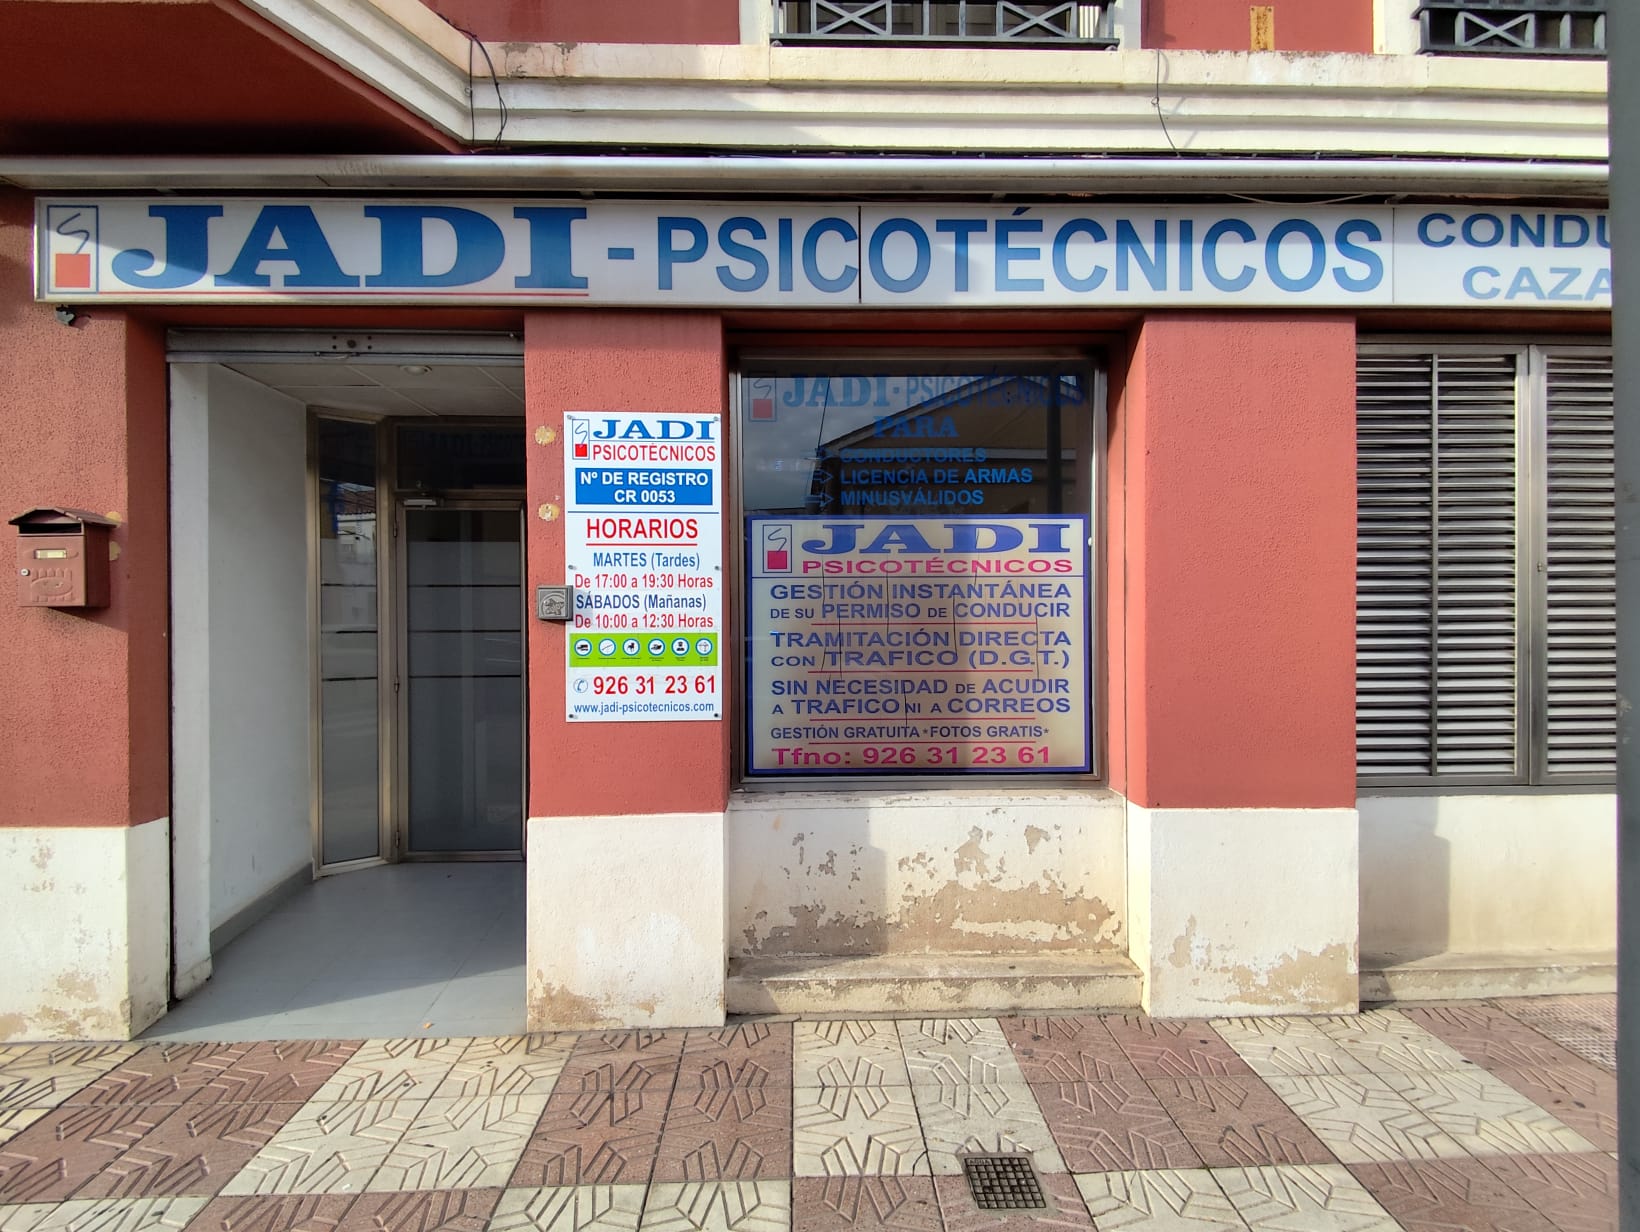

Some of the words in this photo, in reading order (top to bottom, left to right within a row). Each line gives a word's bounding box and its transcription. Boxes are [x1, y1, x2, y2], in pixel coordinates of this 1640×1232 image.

[111, 205, 589, 289] JADI
[658, 206, 1385, 294] PSICOTÉCNICOS
[782, 374, 890, 408] JADI
[593, 419, 715, 440] JADI
[873, 415, 960, 439] PARA
[593, 443, 716, 462] PSICOTÉCNICOS
[840, 448, 987, 464] CONDUCTORES
[580, 471, 598, 485] Nº
[602, 472, 624, 485] DE
[628, 472, 709, 486] REGISTRO
[935, 469, 960, 484] DE
[964, 467, 1033, 484] ARMAS
[614, 490, 637, 503] CR
[641, 490, 676, 503] 0053
[840, 487, 985, 506] MINUSVÁLIDOS
[587, 518, 698, 539] HORARIOS
[801, 524, 1071, 555] JADI
[593, 552, 647, 568] MARTES
[651, 552, 700, 571] (Tardes)
[802, 557, 1073, 574] PSICOTÉCNICOS
[575, 574, 591, 588] De
[595, 573, 627, 589] 17:00
[631, 577, 638, 588] a
[642, 573, 674, 588] 19:30
[678, 573, 713, 588] Horas
[770, 580, 883, 600] GESTIÓN
[892, 580, 1072, 600] INSTANTÁNEA
[576, 591, 640, 609] SÁBADOS
[644, 593, 707, 612] (Mañanas)
[770, 608, 792, 619] DE
[795, 608, 815, 619] SU
[822, 602, 921, 619] PERMISO
[928, 607, 947, 619] DE
[954, 602, 1070, 619] CONDUCIR
[575, 614, 591, 629] De
[595, 614, 627, 629] 10:00
[631, 617, 638, 628] a
[643, 613, 674, 628] 12:30
[678, 613, 714, 628] Horas
[770, 628, 950, 648] TRAMITACIÓN
[960, 630, 1072, 647] DIRECTA
[770, 656, 816, 668] CON
[825, 650, 958, 667] TRAFICO
[968, 649, 1070, 670] (D.G.T.)
[593, 676, 629, 695] 926
[635, 676, 655, 694] 31
[665, 675, 688, 694] 23
[694, 675, 715, 694] 61
[771, 680, 808, 695] SIN
[816, 678, 948, 695] NECESIDAD
[955, 683, 976, 694] DE
[982, 678, 1070, 694] ACUDIR
[574, 701, 714, 716] www.jadi-psicotecnicos.com
[772, 703, 784, 714] A
[791, 698, 900, 714] TRAFICO
[905, 703, 921, 713] NI
[930, 703, 942, 713] A
[947, 698, 1071, 714] CORREOS
[770, 724, 839, 739] GESTIÓN
[844, 726, 920, 739] GRATUITA
[772, 748, 851, 766] Tfno:
[863, 747, 916, 765] 926
[927, 747, 958, 764] 31
[972, 746, 1007, 764] 23
[1018, 746, 1050, 764] 61
